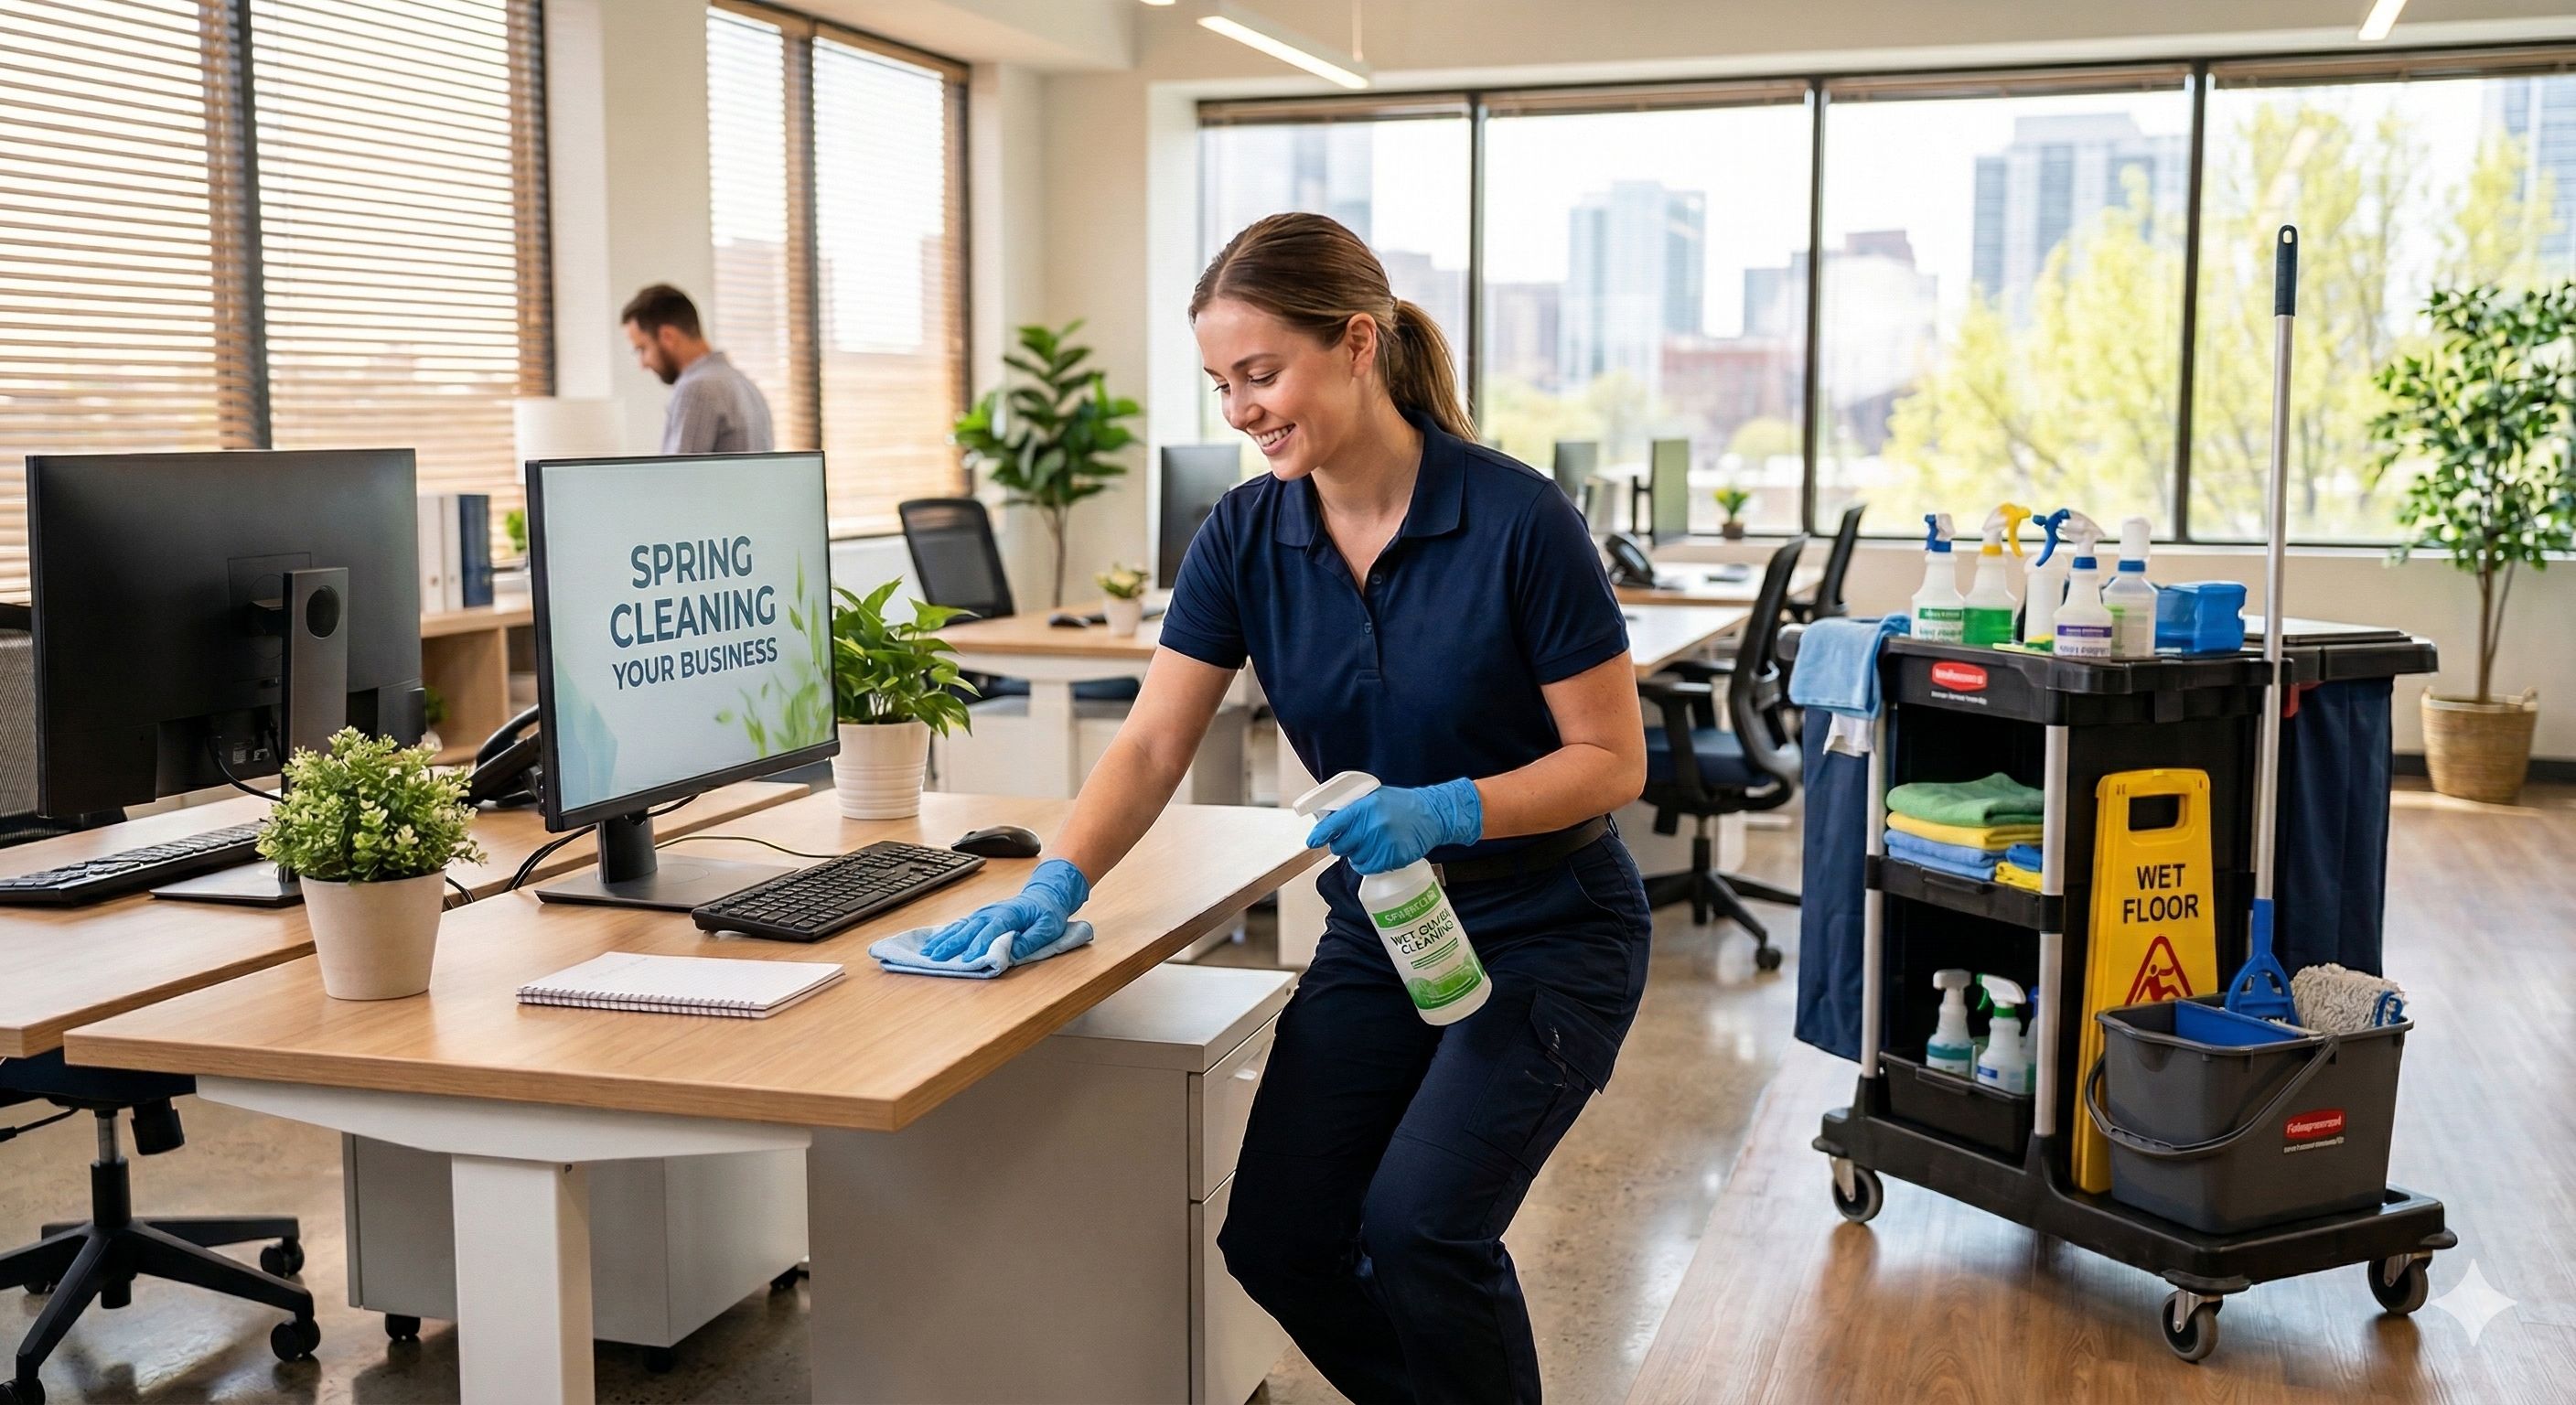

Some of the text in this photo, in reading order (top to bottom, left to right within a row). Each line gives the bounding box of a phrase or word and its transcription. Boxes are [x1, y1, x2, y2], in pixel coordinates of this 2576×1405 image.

[630, 535, 753, 589] SPRING
[609, 585, 777, 649] CLEANING
[611, 637, 778, 691] YOUR BUSINESS
[2137, 863, 2186, 890] WET
[2123, 894, 2199, 924] FLOOR
[1390, 929, 1416, 947] WET
